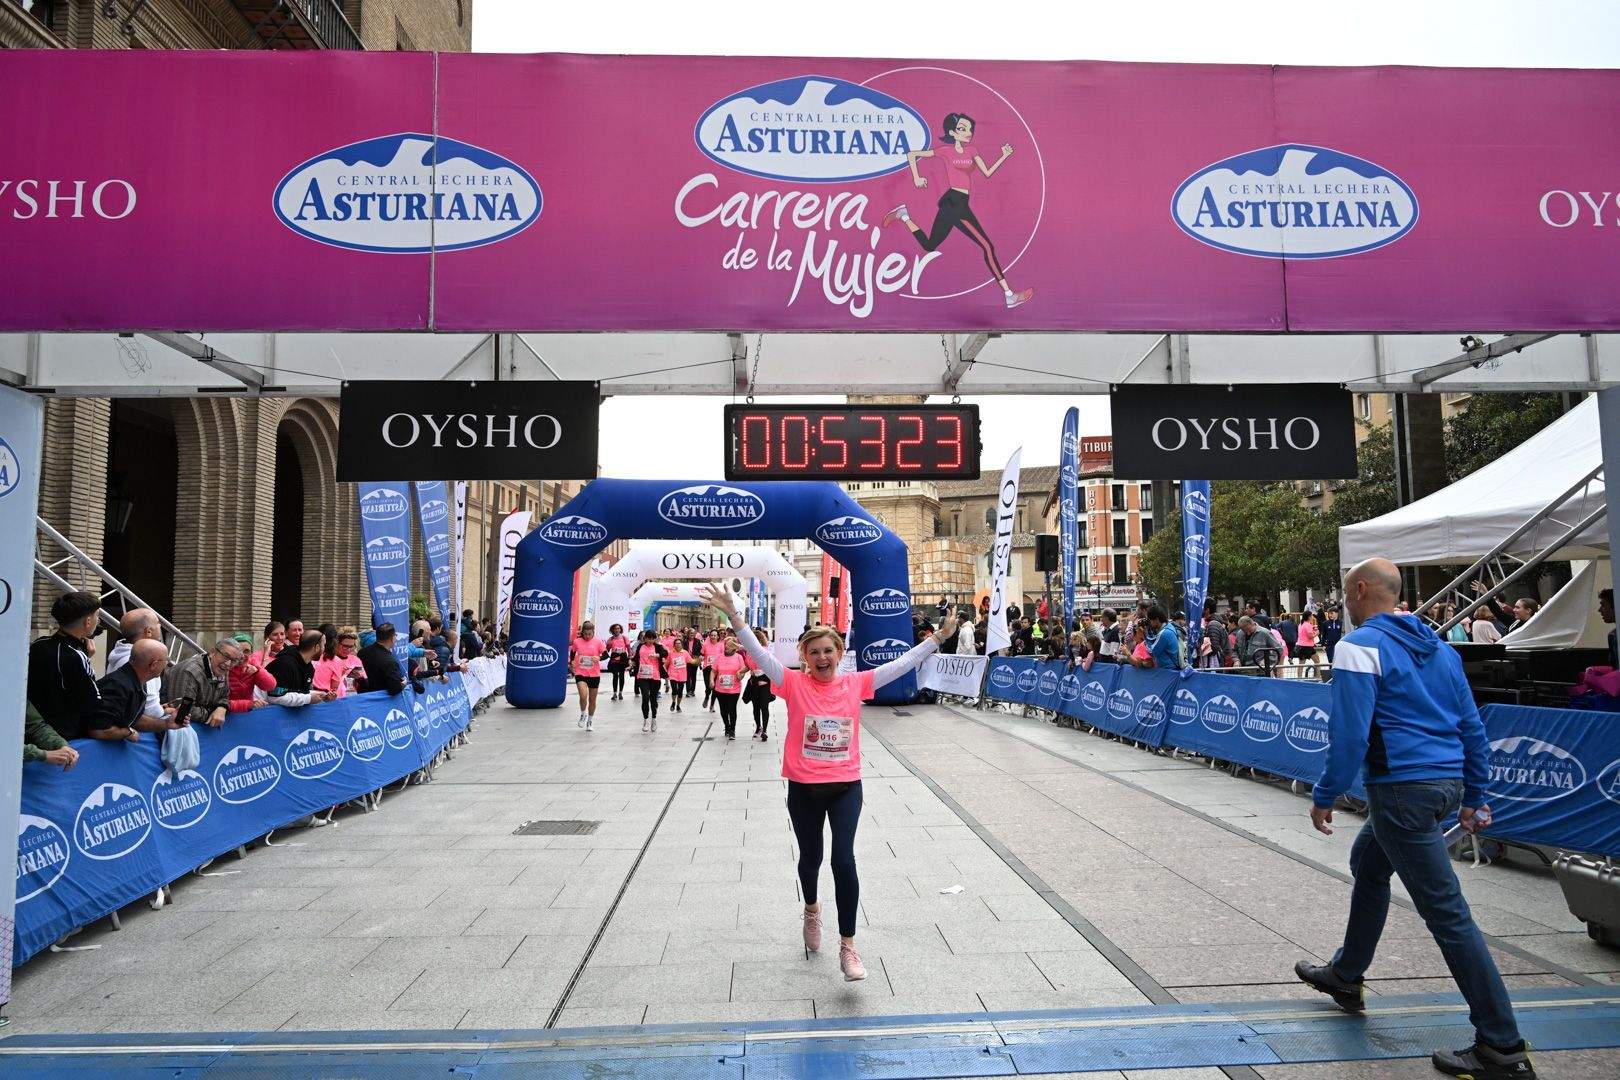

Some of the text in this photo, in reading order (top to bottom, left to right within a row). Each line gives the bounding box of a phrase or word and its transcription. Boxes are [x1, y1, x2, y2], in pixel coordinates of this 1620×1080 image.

[751, 112, 905, 125] CENTRAL LECHERA
[713, 113, 912, 155] ASTURIANA
[337, 174, 513, 187] CENTRAL LECHERA
[1228, 184, 1391, 195] CENTRAL LECHERA
[0, 178, 137, 220] SHO
[294, 177, 522, 222] ASTURIANA
[674, 173, 870, 230] Carrera
[1192, 186, 1401, 229] ASTURIANA
[1539, 189, 1620, 229] OY
[722, 225, 942, 318] de la Mujer
[381, 412, 562, 450] OYSHO
[1151, 416, 1320, 452] OYSHO
[666, 498, 757, 519] ASTURIANA
[544, 526, 602, 540] ASTURIANA
[821, 527, 879, 540] ASTURIANA
[662, 552, 745, 570] OYSHO
[514, 600, 559, 612] ASTURIANA
[863, 600, 908, 611] ASTURIANA
[509, 649, 554, 662] ASTURIANA
[937, 658, 974, 677] OYSHO
[1203, 706, 1236, 726] ASTURIANA
[1243, 713, 1279, 734] ASTURIANA
[352, 735, 384, 753] ASTURIANA
[291, 747, 342, 772] ASTURIANA
[219, 763, 278, 796] ASTURIANA
[157, 787, 208, 819] ASTURIANA
[82, 807, 150, 851] ASTURIANA
